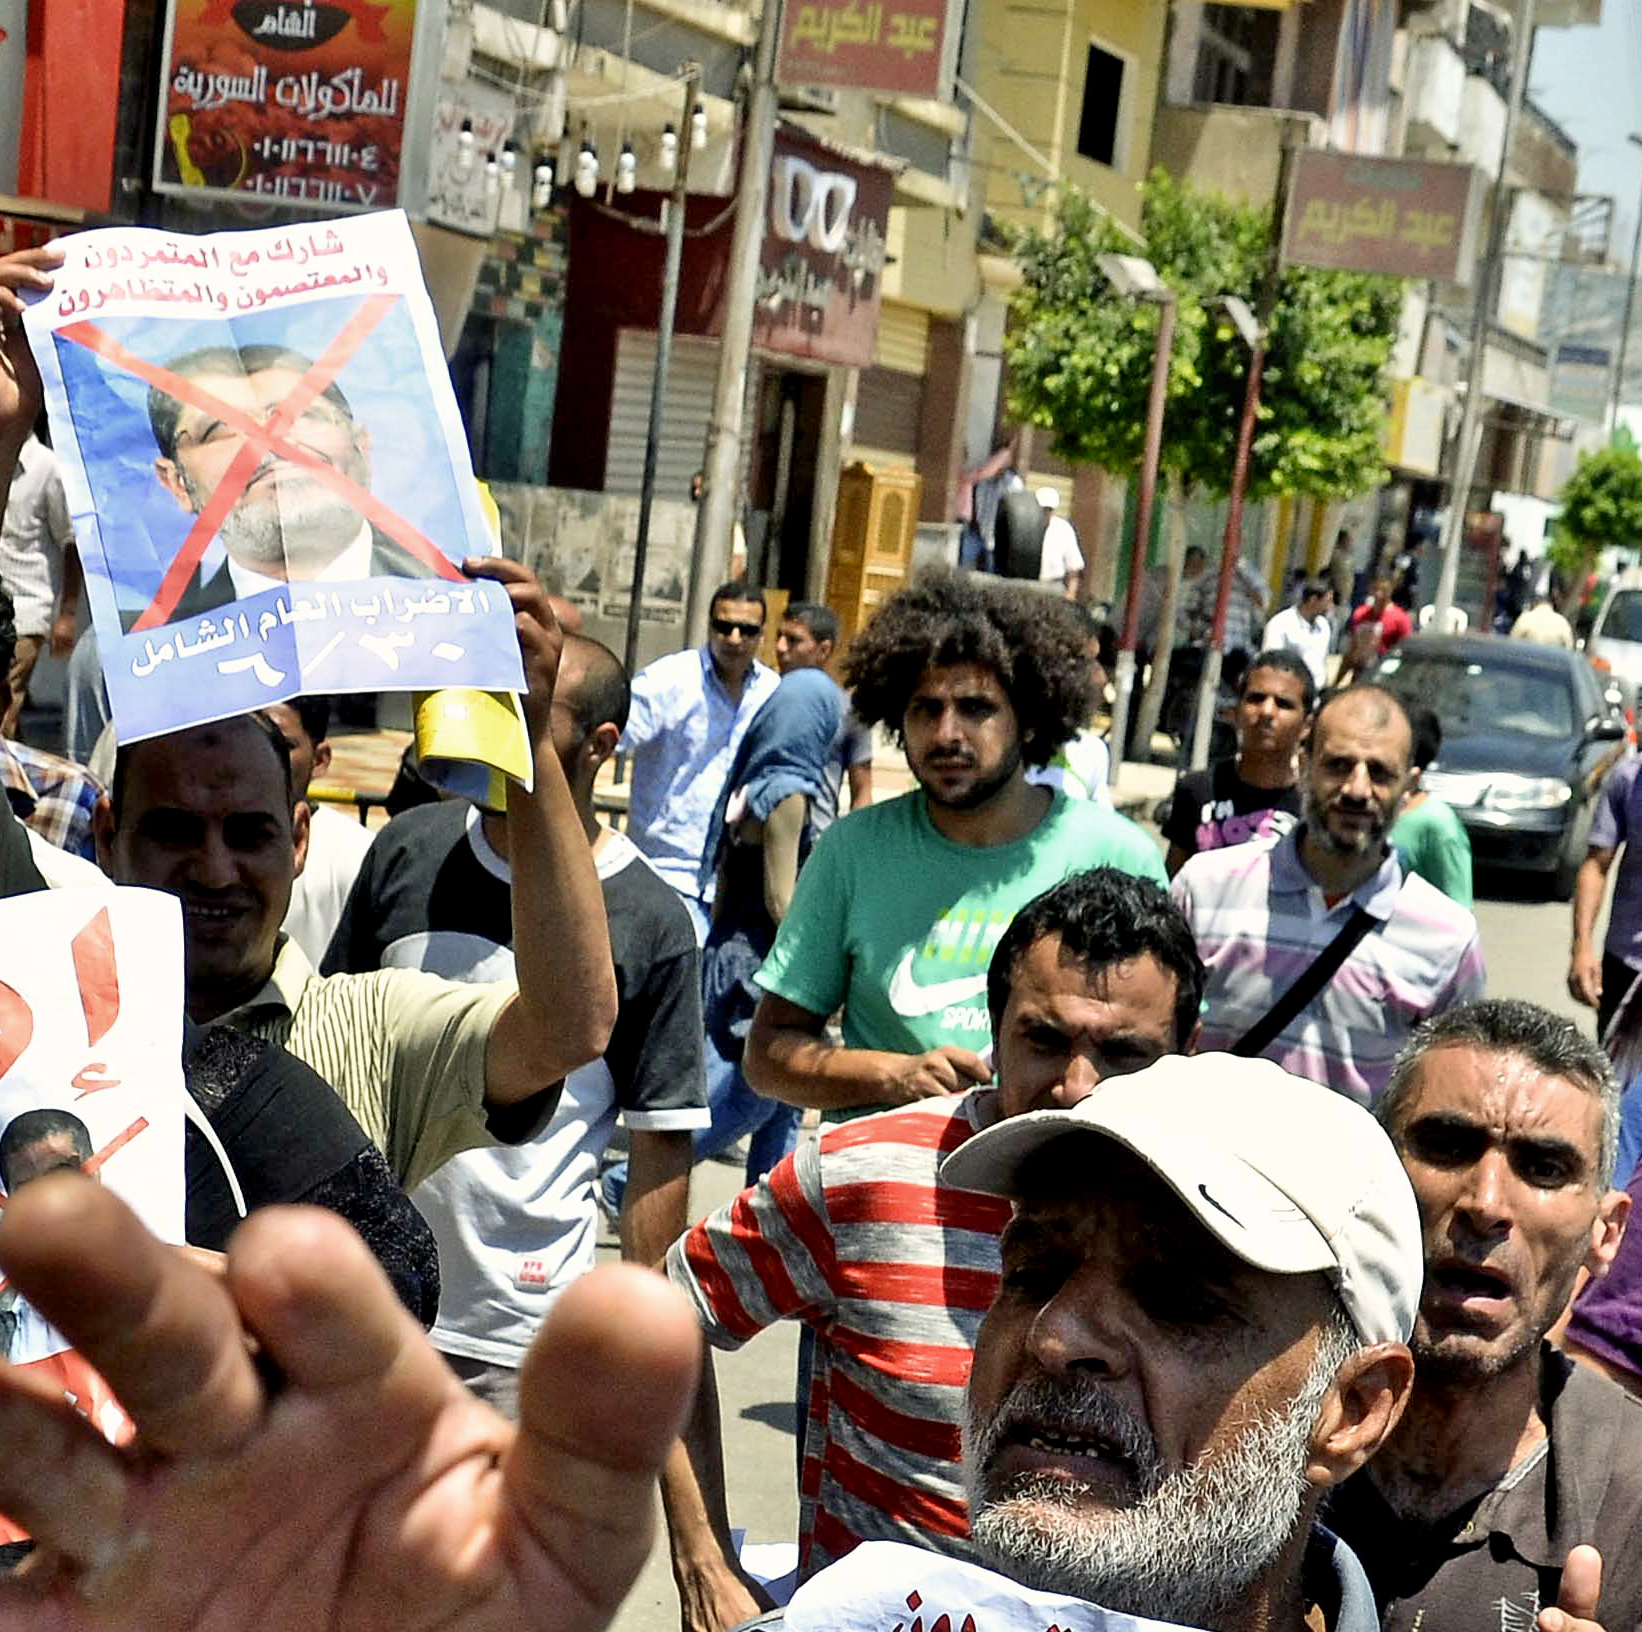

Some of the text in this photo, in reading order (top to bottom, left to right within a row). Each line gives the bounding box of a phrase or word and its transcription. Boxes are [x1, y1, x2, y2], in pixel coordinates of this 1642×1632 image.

[173, 65, 267, 110] السورية
[84, 230, 344, 276] شارك مع المتمردون
[58, 263, 388, 317] والمعتصمون والمتظاهرون
[258, 591, 343, 642] العام
[130, 612, 250, 678] الشامل
